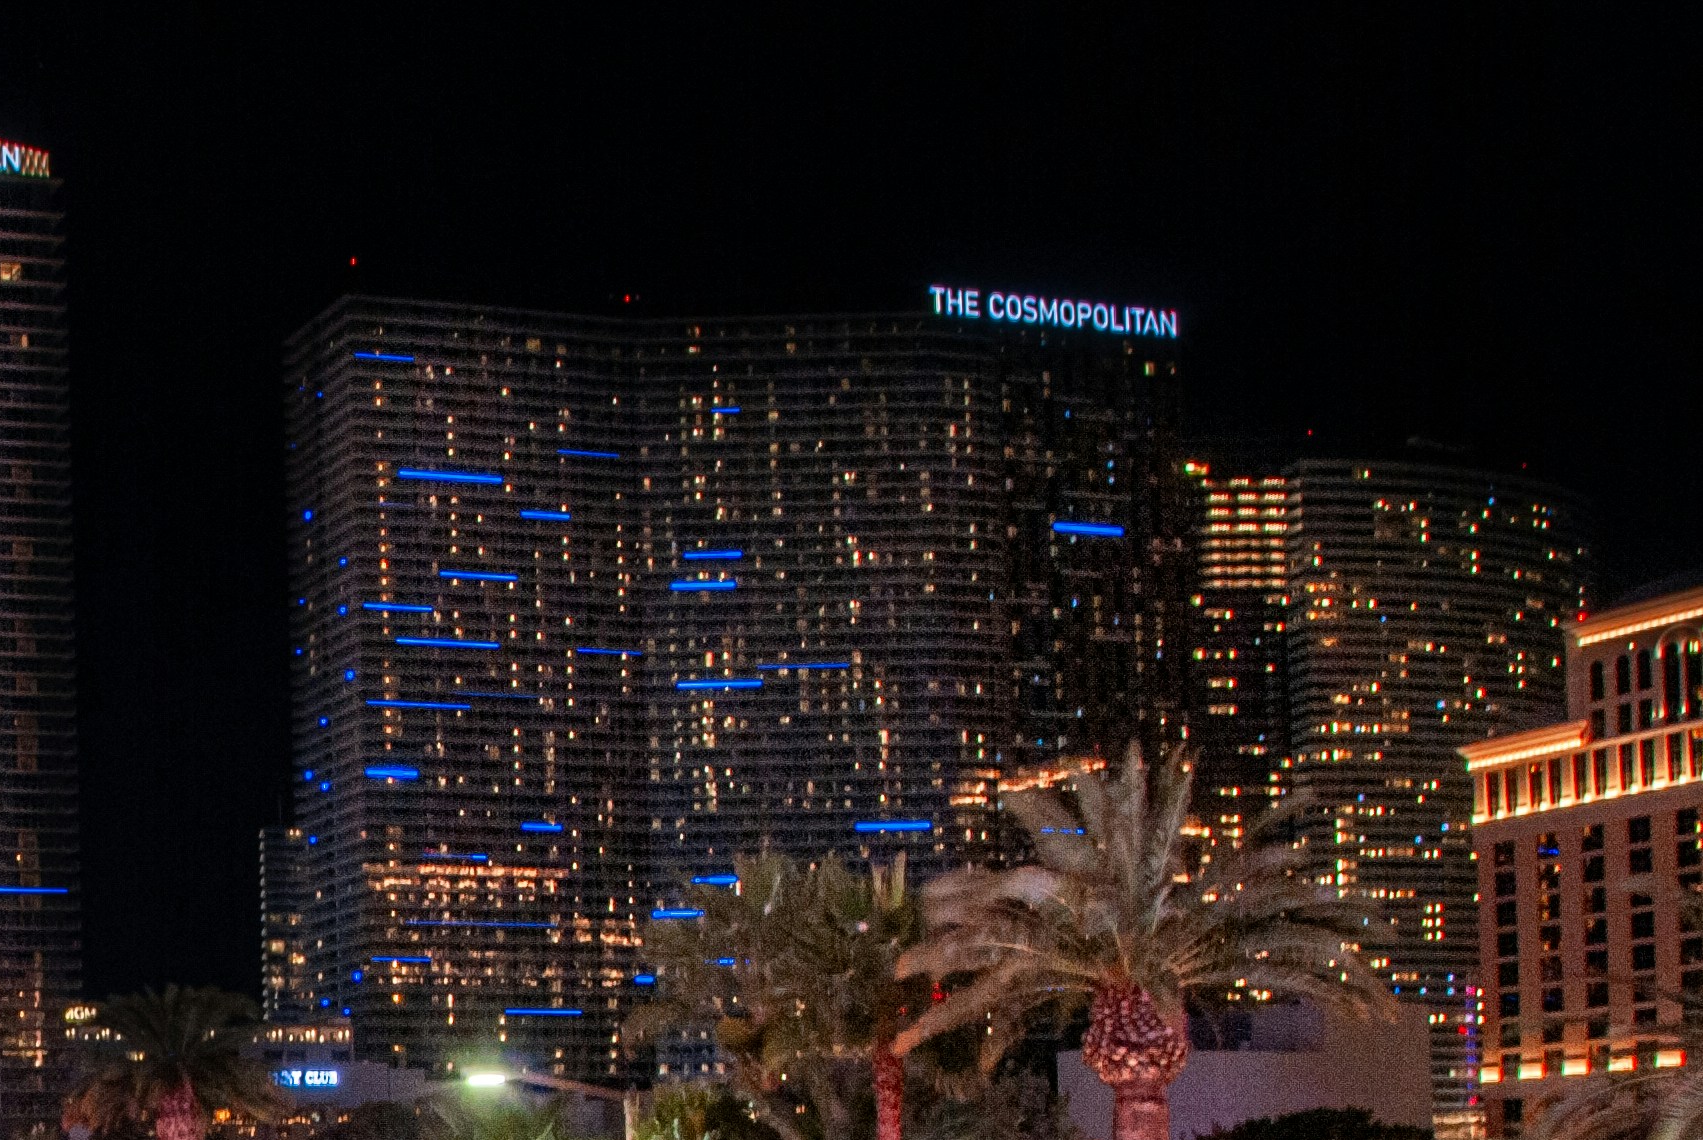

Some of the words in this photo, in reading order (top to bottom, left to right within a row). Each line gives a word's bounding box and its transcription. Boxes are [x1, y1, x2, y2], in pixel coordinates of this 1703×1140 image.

[929, 284, 981, 318] THE
[988, 291, 1179, 339] COSMOPOLITAN
[305, 1069, 338, 1086] CLUB
